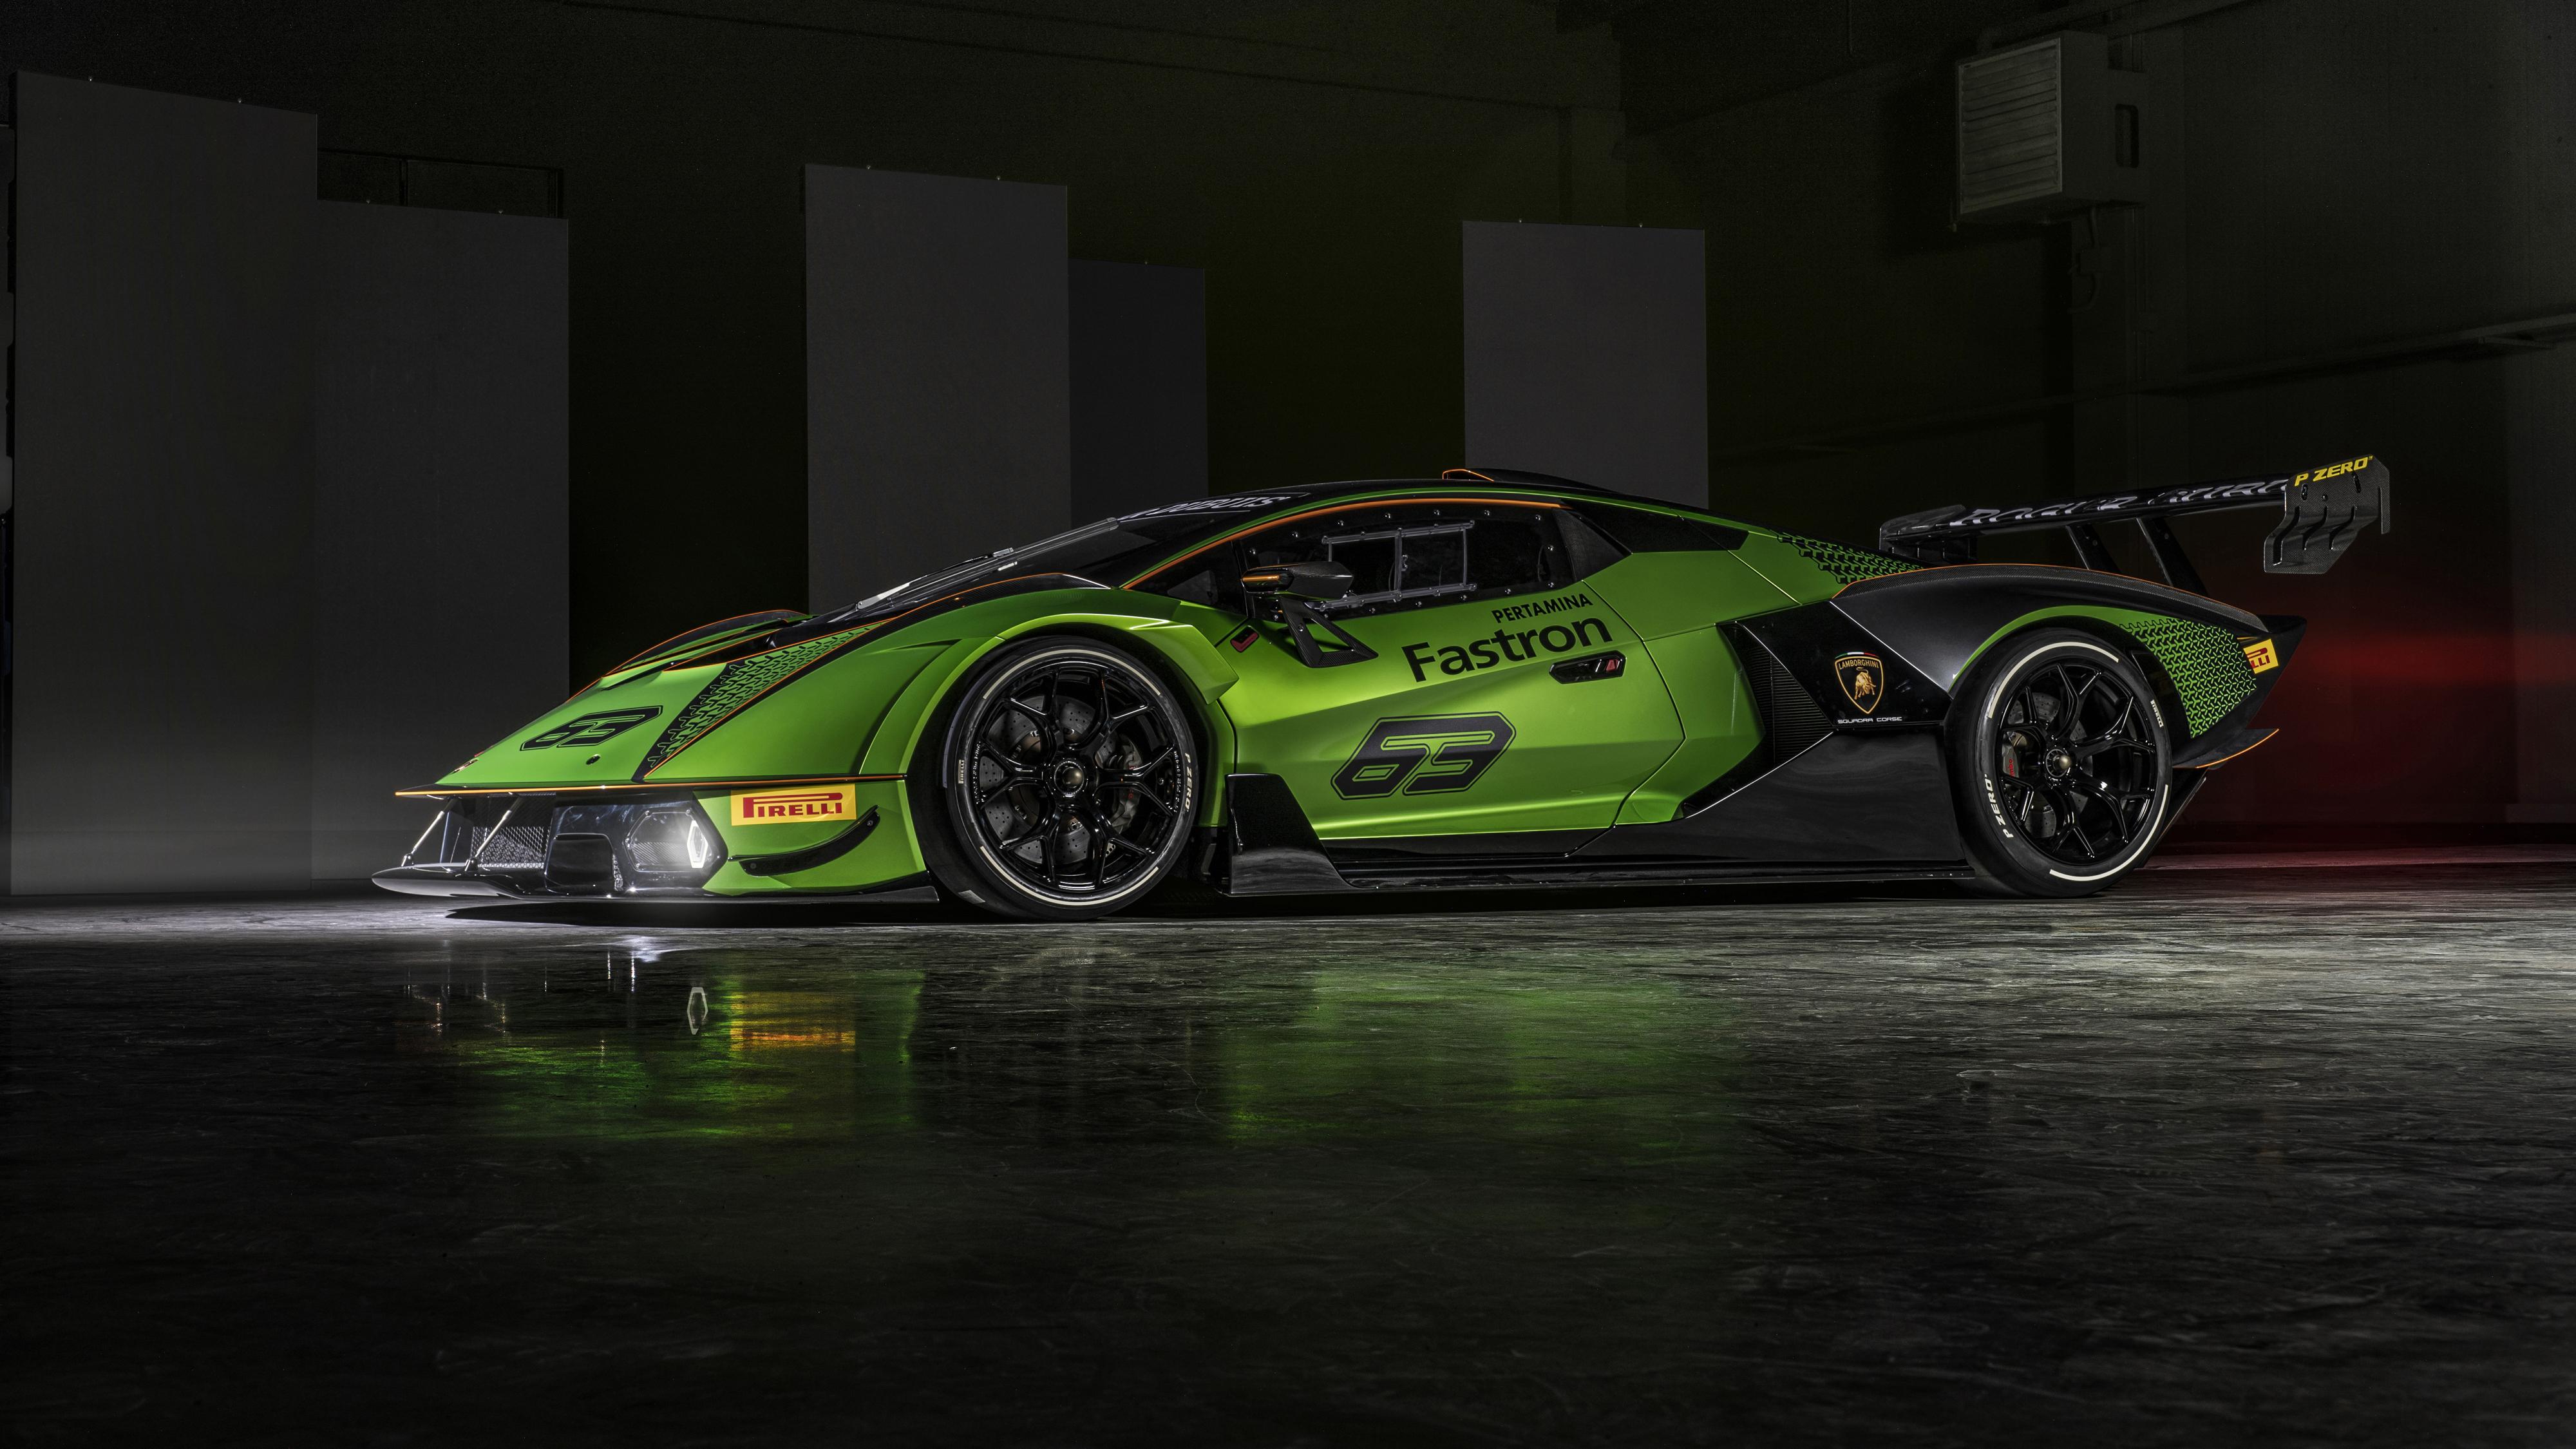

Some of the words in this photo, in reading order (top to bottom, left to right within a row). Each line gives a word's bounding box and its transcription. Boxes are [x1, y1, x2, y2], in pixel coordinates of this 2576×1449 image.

[2294, 473, 2309, 487] P
[1491, 592, 1593, 624] PERTAMINA
[1401, 617, 1613, 683] Fastron
[1838, 659, 1879, 670] LAMBORGHINI
[519, 705, 663, 752] 63
[1184, 752, 1191, 763] P
[1331, 711, 1517, 800] 63
[743, 792, 844, 819] PIRELLI
[1984, 778, 2006, 826] ZERO
[2003, 828, 2014, 839] P
